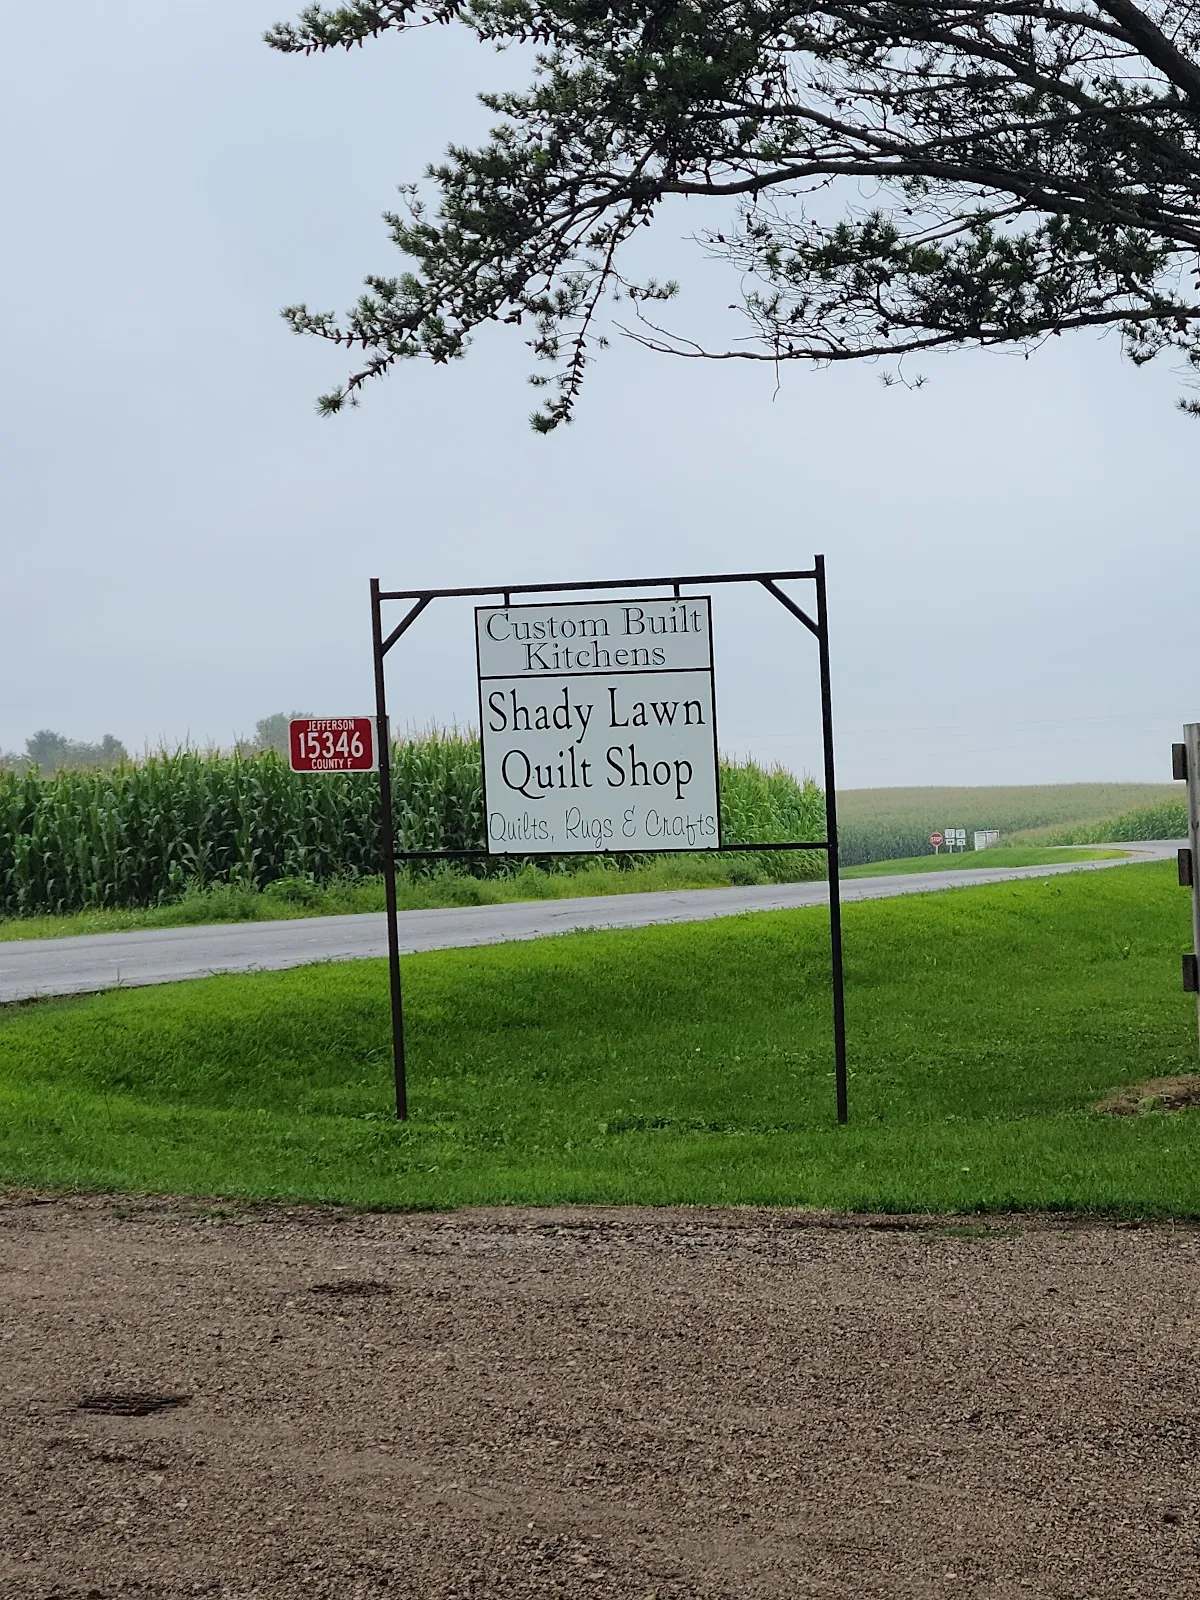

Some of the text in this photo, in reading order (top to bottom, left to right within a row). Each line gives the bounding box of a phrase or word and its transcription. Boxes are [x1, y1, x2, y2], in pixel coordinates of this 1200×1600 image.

[486, 604, 702, 641] Custom Built
[522, 640, 666, 671] Kitchens
[307, 720, 354, 731] JEFFERSON
[488, 686, 706, 743] Shady Lawn
[299, 731, 363, 758] 15346
[311, 758, 353, 769] COUNTY F
[502, 744, 693, 800] Quilt Shop
[489, 805, 716, 848] Quilts, Rugs & Crafts
